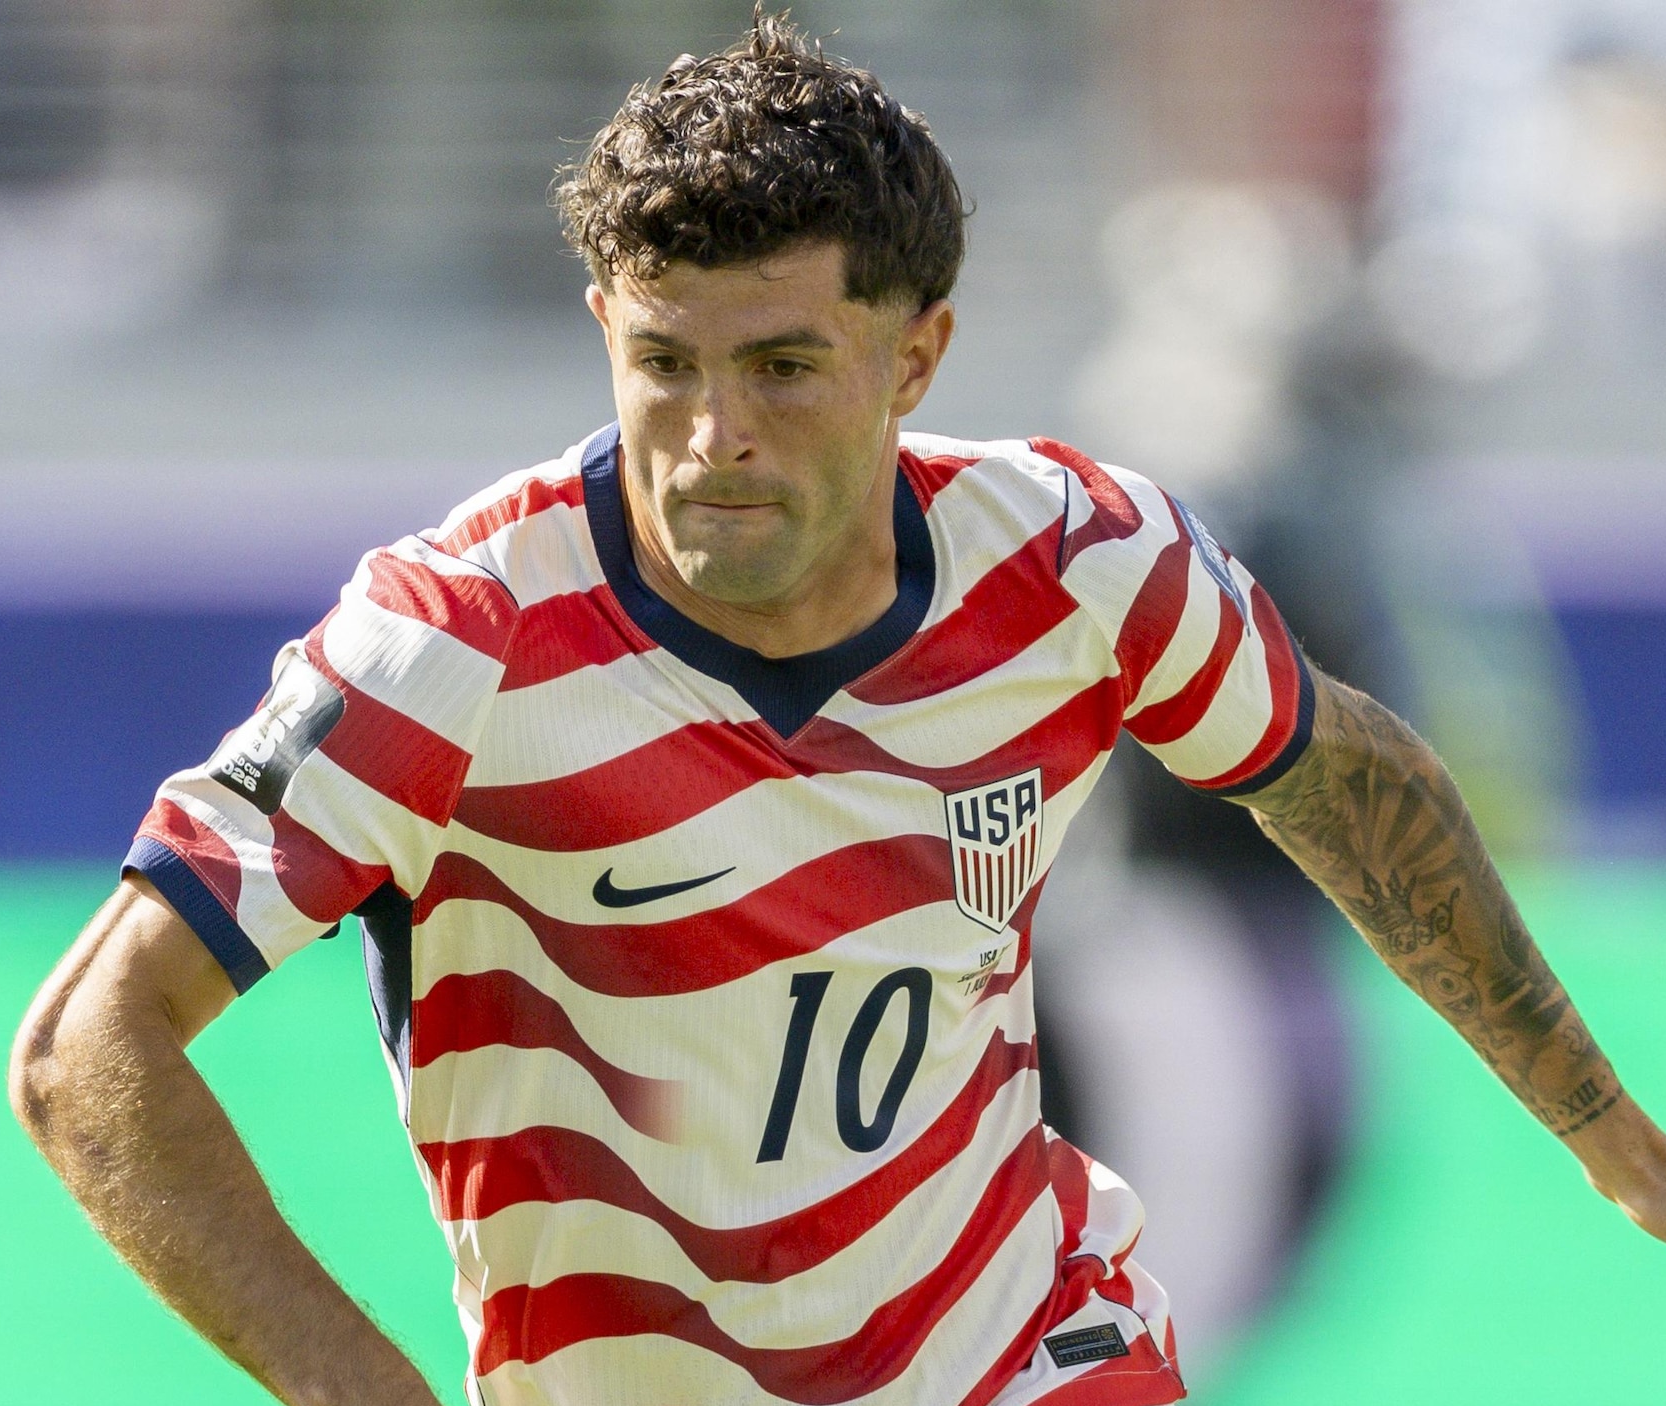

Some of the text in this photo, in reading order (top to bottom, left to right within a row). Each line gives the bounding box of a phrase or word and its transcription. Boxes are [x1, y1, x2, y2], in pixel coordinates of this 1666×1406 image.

[220, 760, 258, 793] 026
[244, 762, 262, 779] CUP
[955, 778, 1036, 847] USA
[979, 949, 998, 967] USA
[755, 966, 933, 1164] 10
